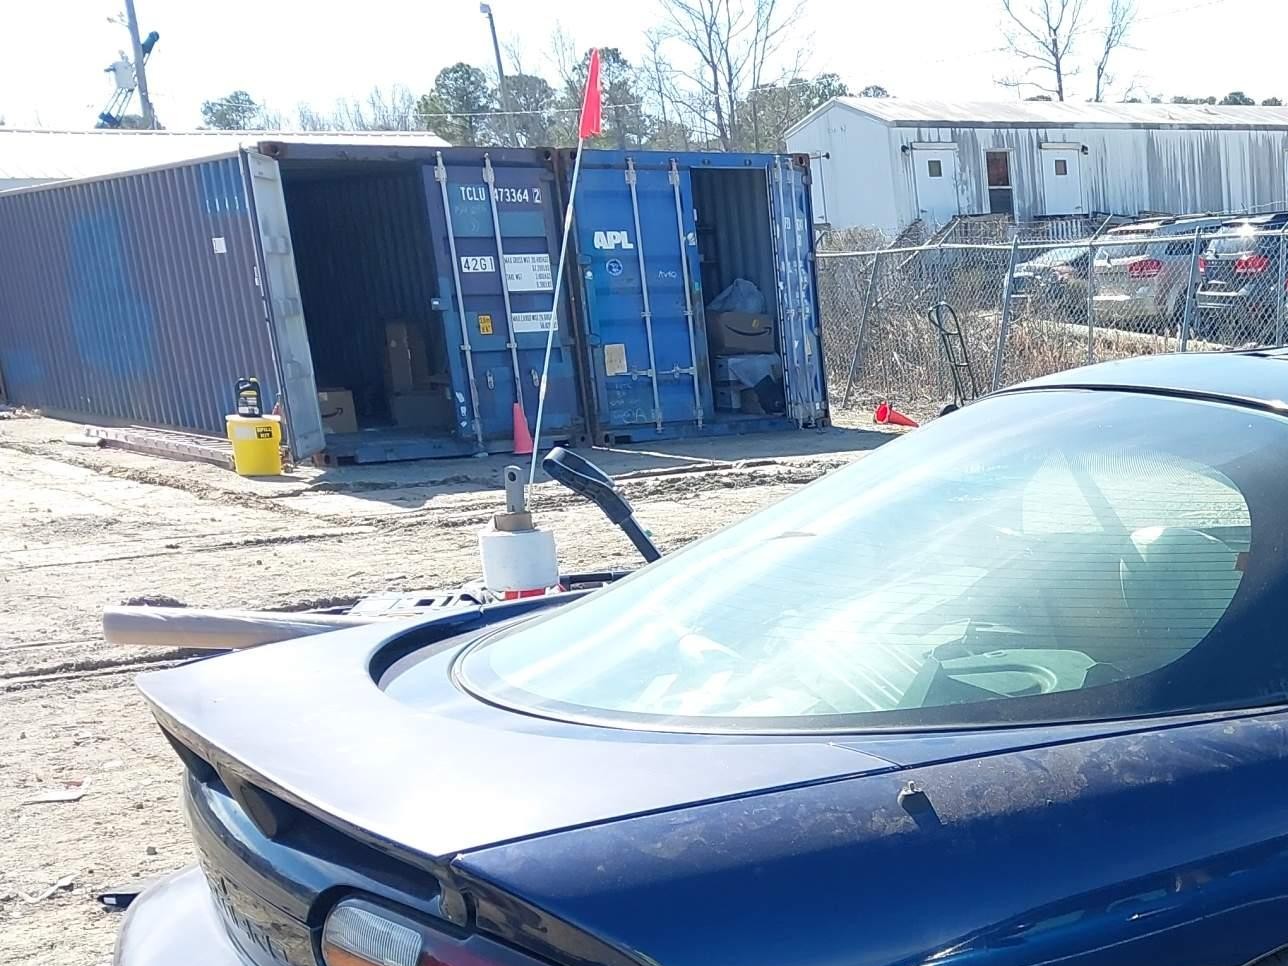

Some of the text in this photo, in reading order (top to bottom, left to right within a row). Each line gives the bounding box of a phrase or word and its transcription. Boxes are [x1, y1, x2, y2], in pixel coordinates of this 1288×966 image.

[460, 186, 486, 201] TCLU
[533, 187, 542, 203] 2
[593, 230, 634, 250] APL
[463, 257, 494, 271] 42G1
